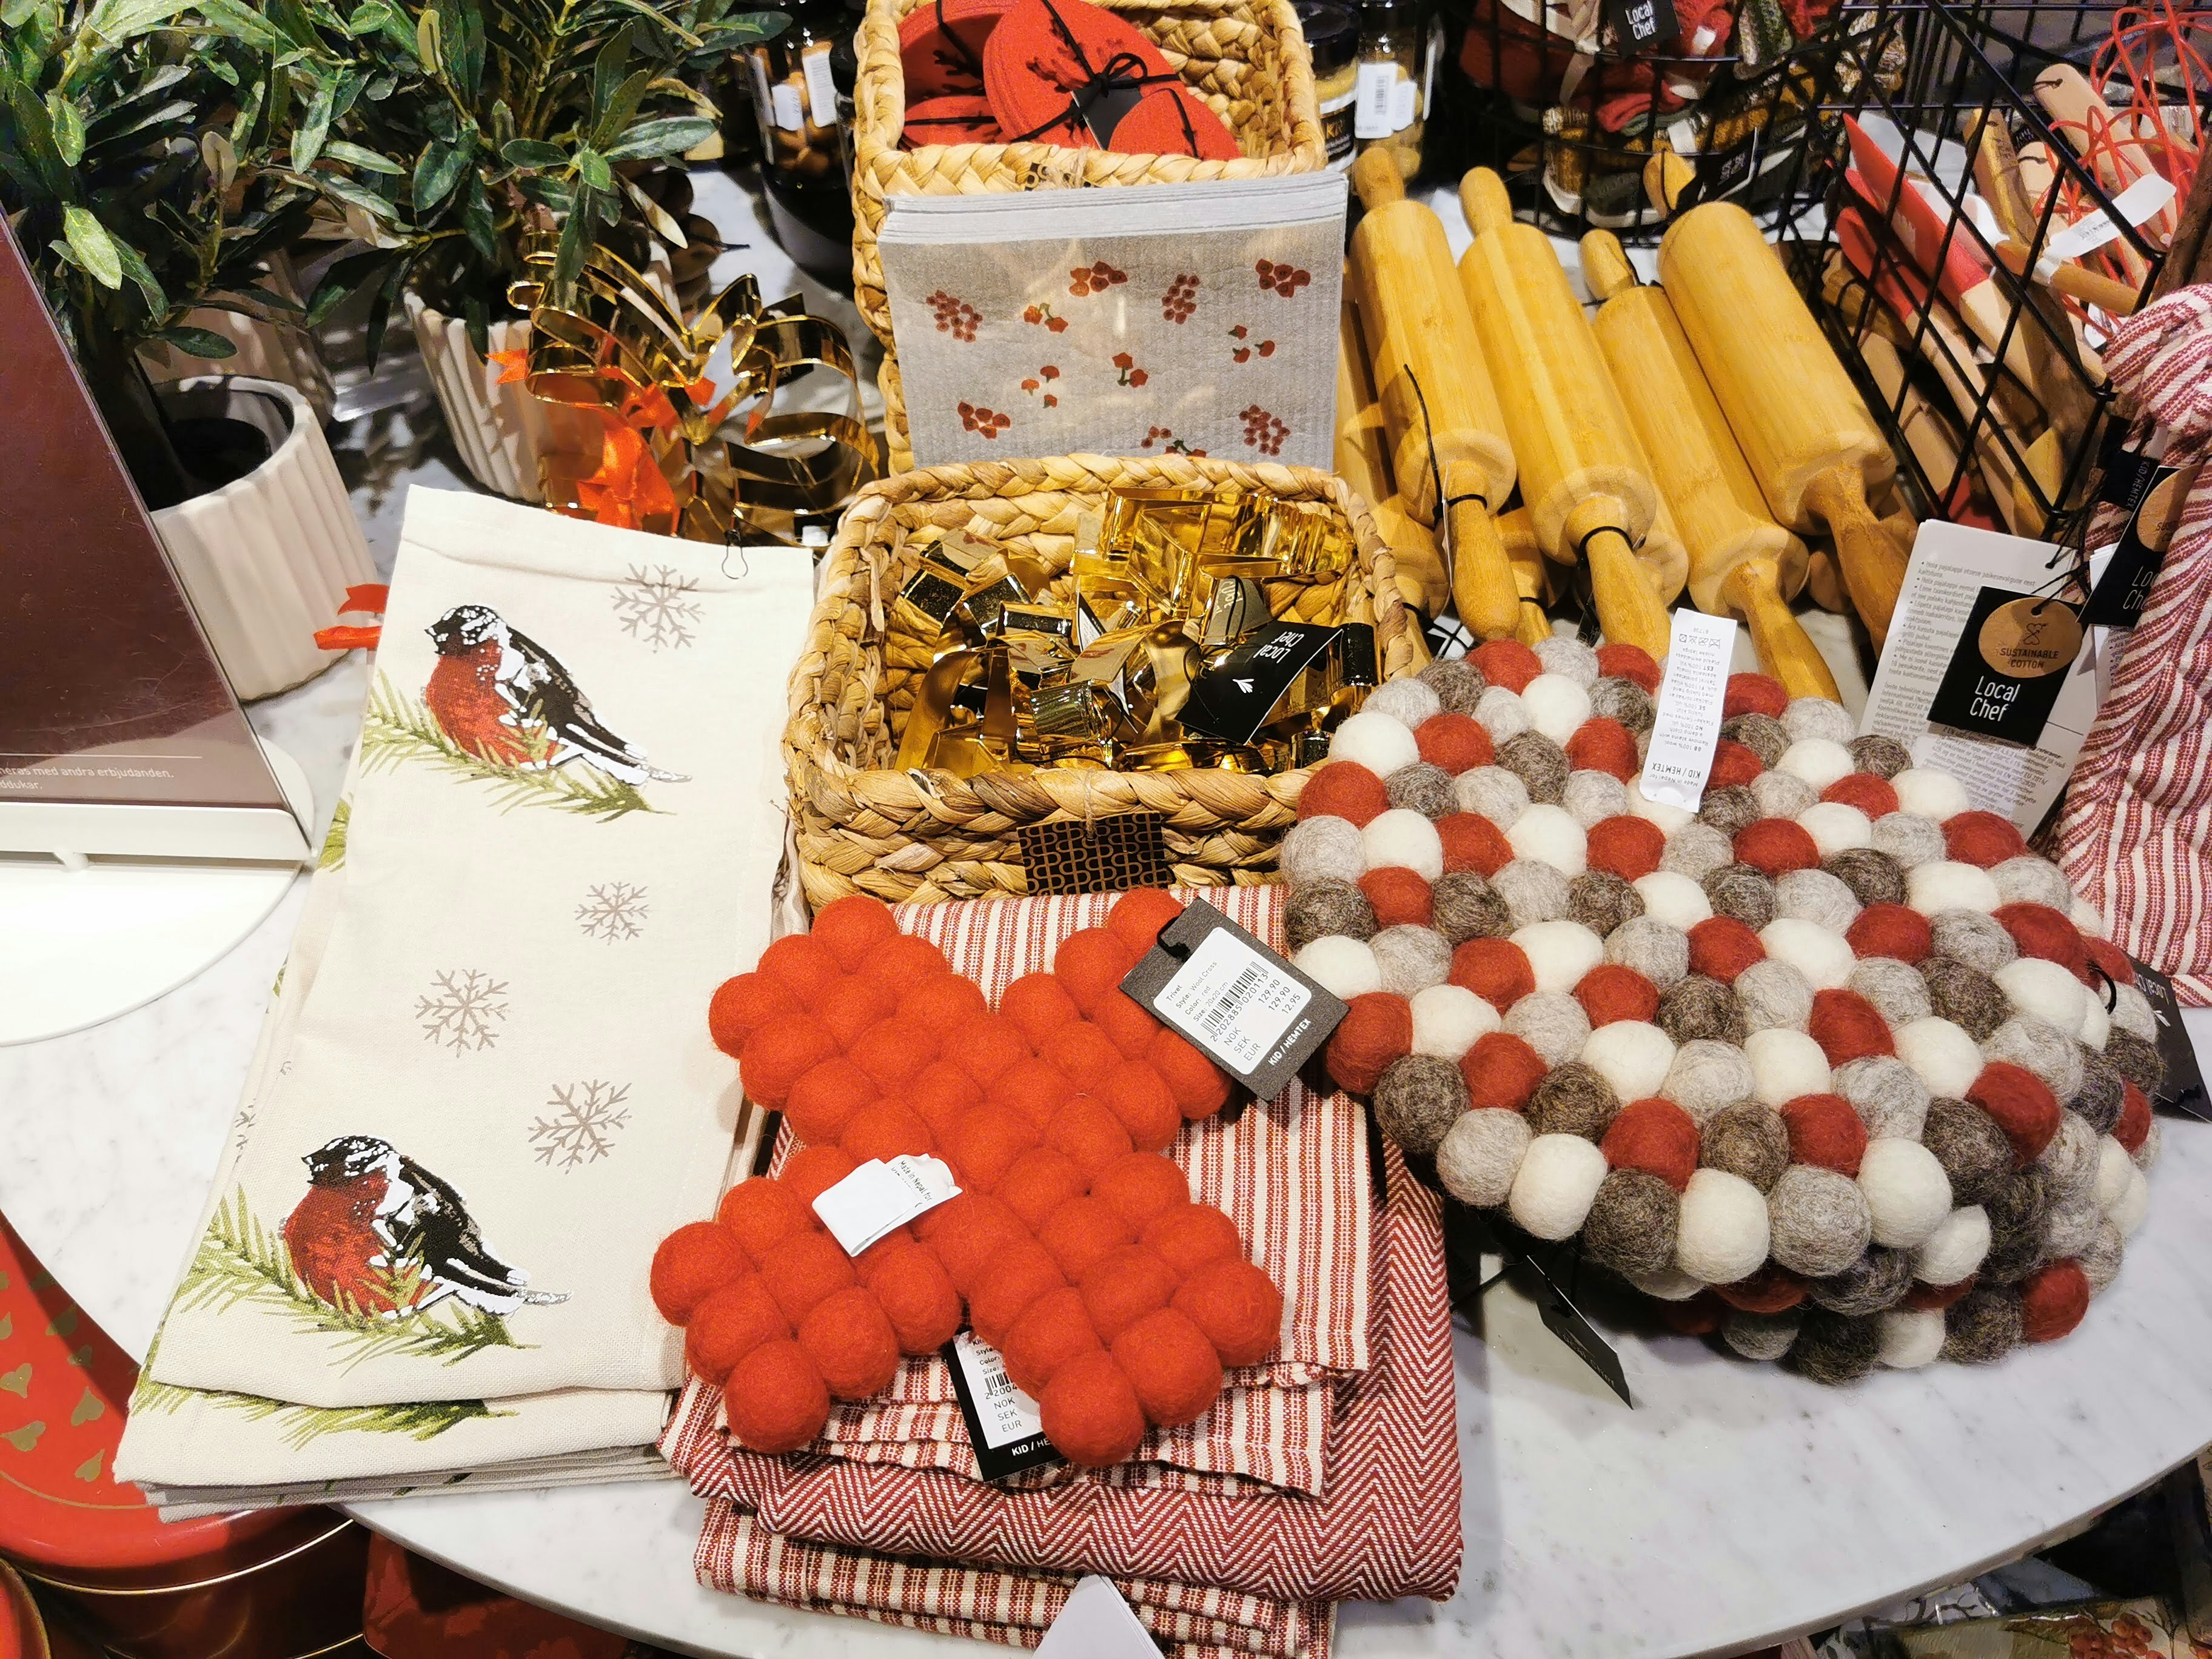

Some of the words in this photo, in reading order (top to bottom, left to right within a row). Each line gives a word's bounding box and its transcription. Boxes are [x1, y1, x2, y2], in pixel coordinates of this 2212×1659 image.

[1624, 0, 1653, 24] Local
[1632, 16, 1657, 39] Chef
[1271, 631, 1305, 648] Chef
[1253, 644, 1291, 664] Local
[1999, 648, 2059, 659] SUSTAINABLE
[2010, 659, 2044, 669] COTTON
[1975, 675, 2020, 702] Local
[1970, 697, 2009, 722] Chef
[33, 766, 59, 776] med
[61, 766, 95, 776] andra
[98, 766, 175, 779] erbjudanden.
[1652, 762, 1681, 775] HEMTEX
[1681, 768, 1687, 777] /
[1688, 769, 1700, 779] KID
[1165, 985, 1182, 1001] Trivet
[1175, 993, 1191, 1008] Style:
[1190, 976, 1204, 991] Wool
[1201, 961, 1218, 977] Cross
[1185, 998, 1201, 1015] Color:
[1201, 985, 1211, 997] red
[1193, 1008, 1207, 1022] Size:
[1205, 990, 1221, 1007] 20x20
[1219, 982, 1228, 991] cm
[1223, 1027, 1242, 1046] NOK
[1258, 979, 1281, 1004] 129.90
[1233, 1036, 1250, 1054] SEK
[1268, 986, 1290, 1011] 129.90
[1243, 1043, 1261, 1061] EUR
[1281, 993, 1301, 1014] 12.95
[1267, 1050, 1283, 1067] KID
[1282, 1016, 1312, 1049] HEMTEX
[898, 1160, 911, 1175] Made
[912, 1178, 928, 1194] Nepal
[923, 1192, 933, 1201] for
[994, 1396, 1016, 1409] NOK
[997, 1409, 1017, 1421] SEK
[1001, 1419, 1022, 1432] EUR
[1011, 1444, 1029, 1456] KID
[1031, 1441, 1034, 1451] /
